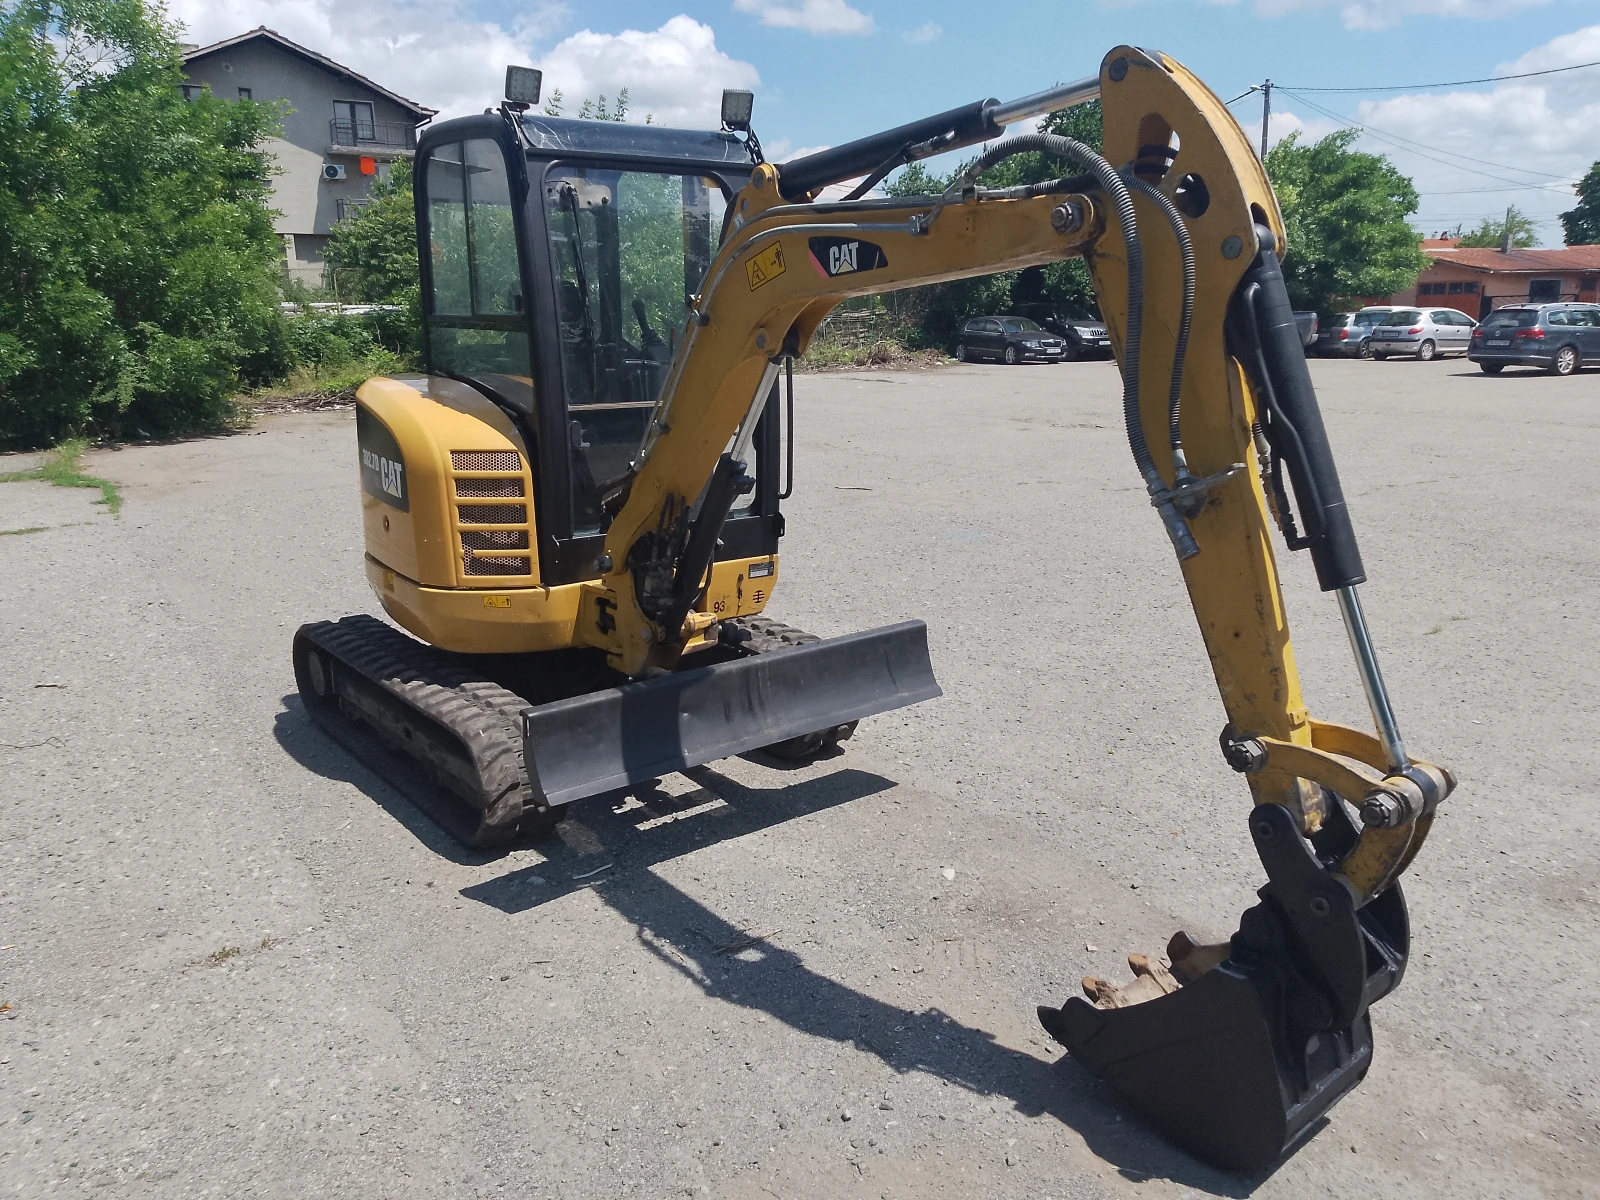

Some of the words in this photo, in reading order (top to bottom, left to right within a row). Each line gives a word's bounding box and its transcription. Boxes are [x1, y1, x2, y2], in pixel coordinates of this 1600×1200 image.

[829, 241, 859, 274] CAT
[380, 456, 403, 498] CAT
[713, 600, 726, 613] 93
